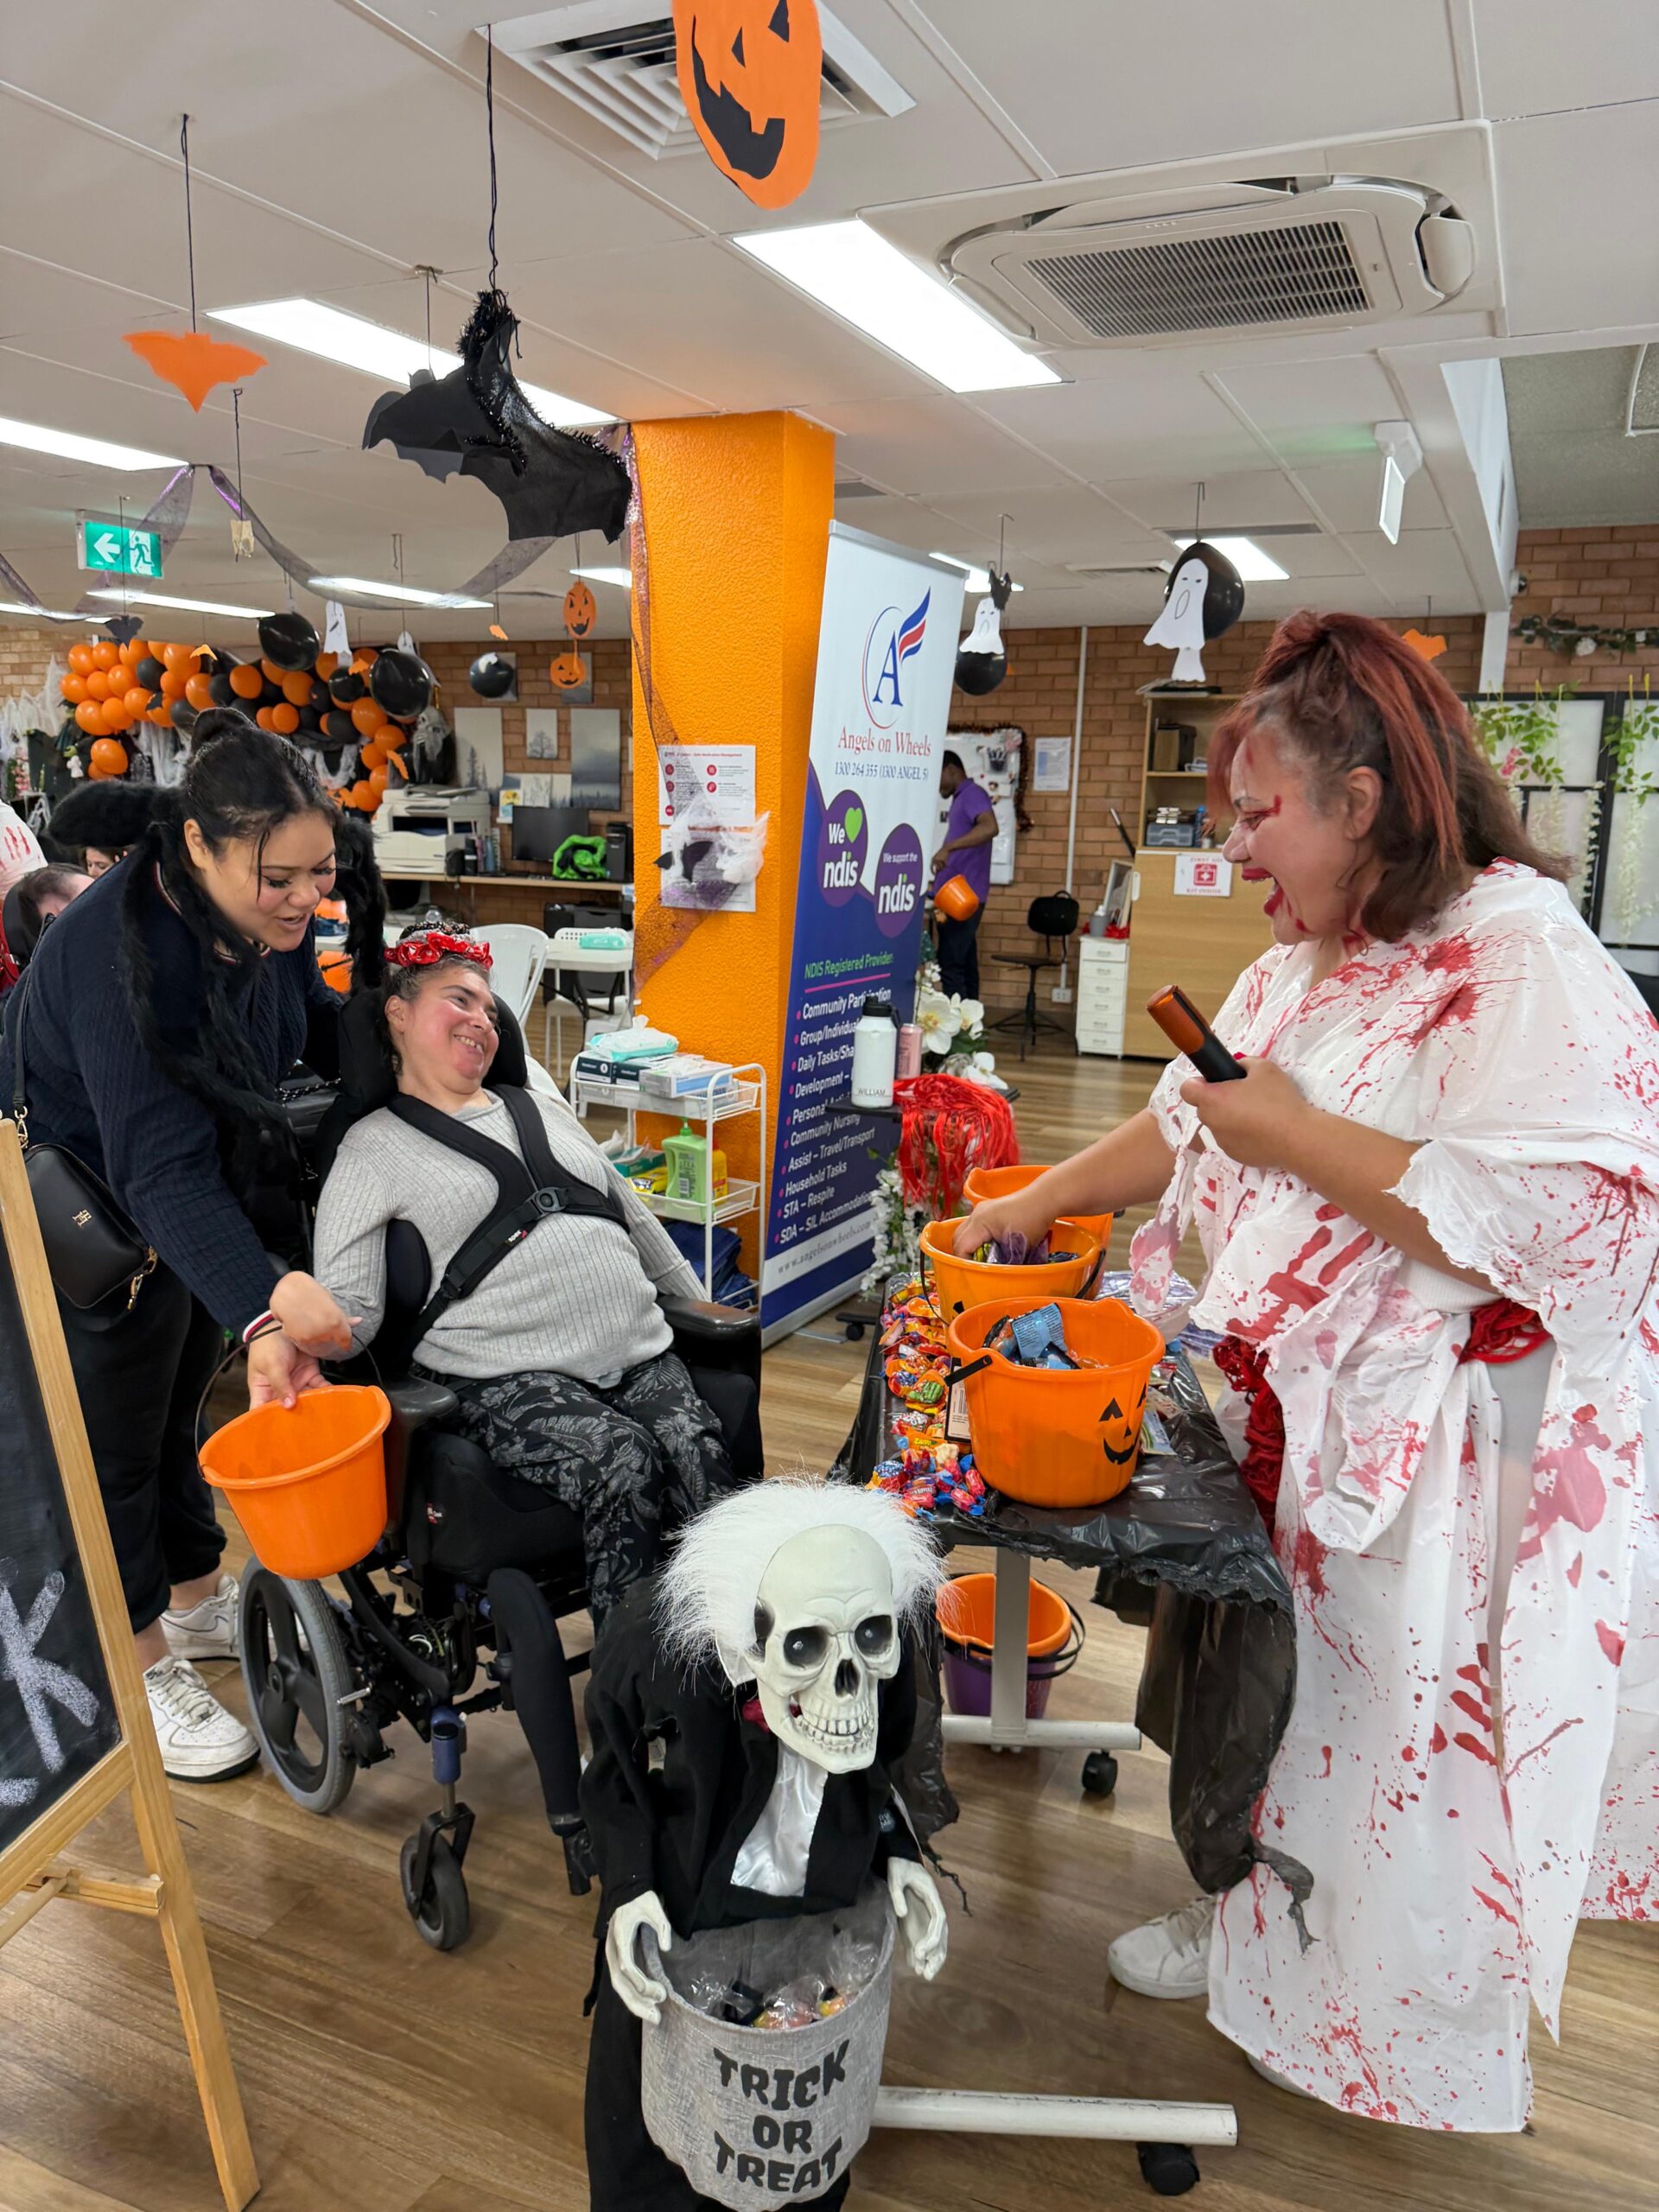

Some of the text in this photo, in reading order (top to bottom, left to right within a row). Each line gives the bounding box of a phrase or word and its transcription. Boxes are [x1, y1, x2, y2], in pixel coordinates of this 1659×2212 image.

[837, 725, 931, 756] Angels on Wheels
[852, 762, 865, 778] 264
[865, 764, 878, 778] 355
[898, 765, 921, 780] ANGEL
[828, 823, 845, 844] We
[823, 850, 858, 888] ndis
[878, 873, 915, 914] ndis
[804, 960, 823, 980] NDIS
[824, 955, 864, 977] Registered
[803, 995, 847, 1020] Community
[800, 1018, 859, 1046] Group/Individua
[798, 1054, 816, 1073] Daily
[795, 1071, 843, 1099] Development
[791, 1114, 861, 1147] Community Nursing
[788, 1151, 812, 1173] Assist
[820, 1126, 875, 1160] Travel/Transport
[785, 1160, 848, 1198] Household Tasks
[783, 1198, 799, 1219] STA
[807, 1185, 835, 1208] Respite
[779, 1224, 798, 1244] SDA
[713, 2038, 850, 2111] TRICK
[752, 2114, 813, 2154] OR
[714, 2129, 843, 2194] TREAT
